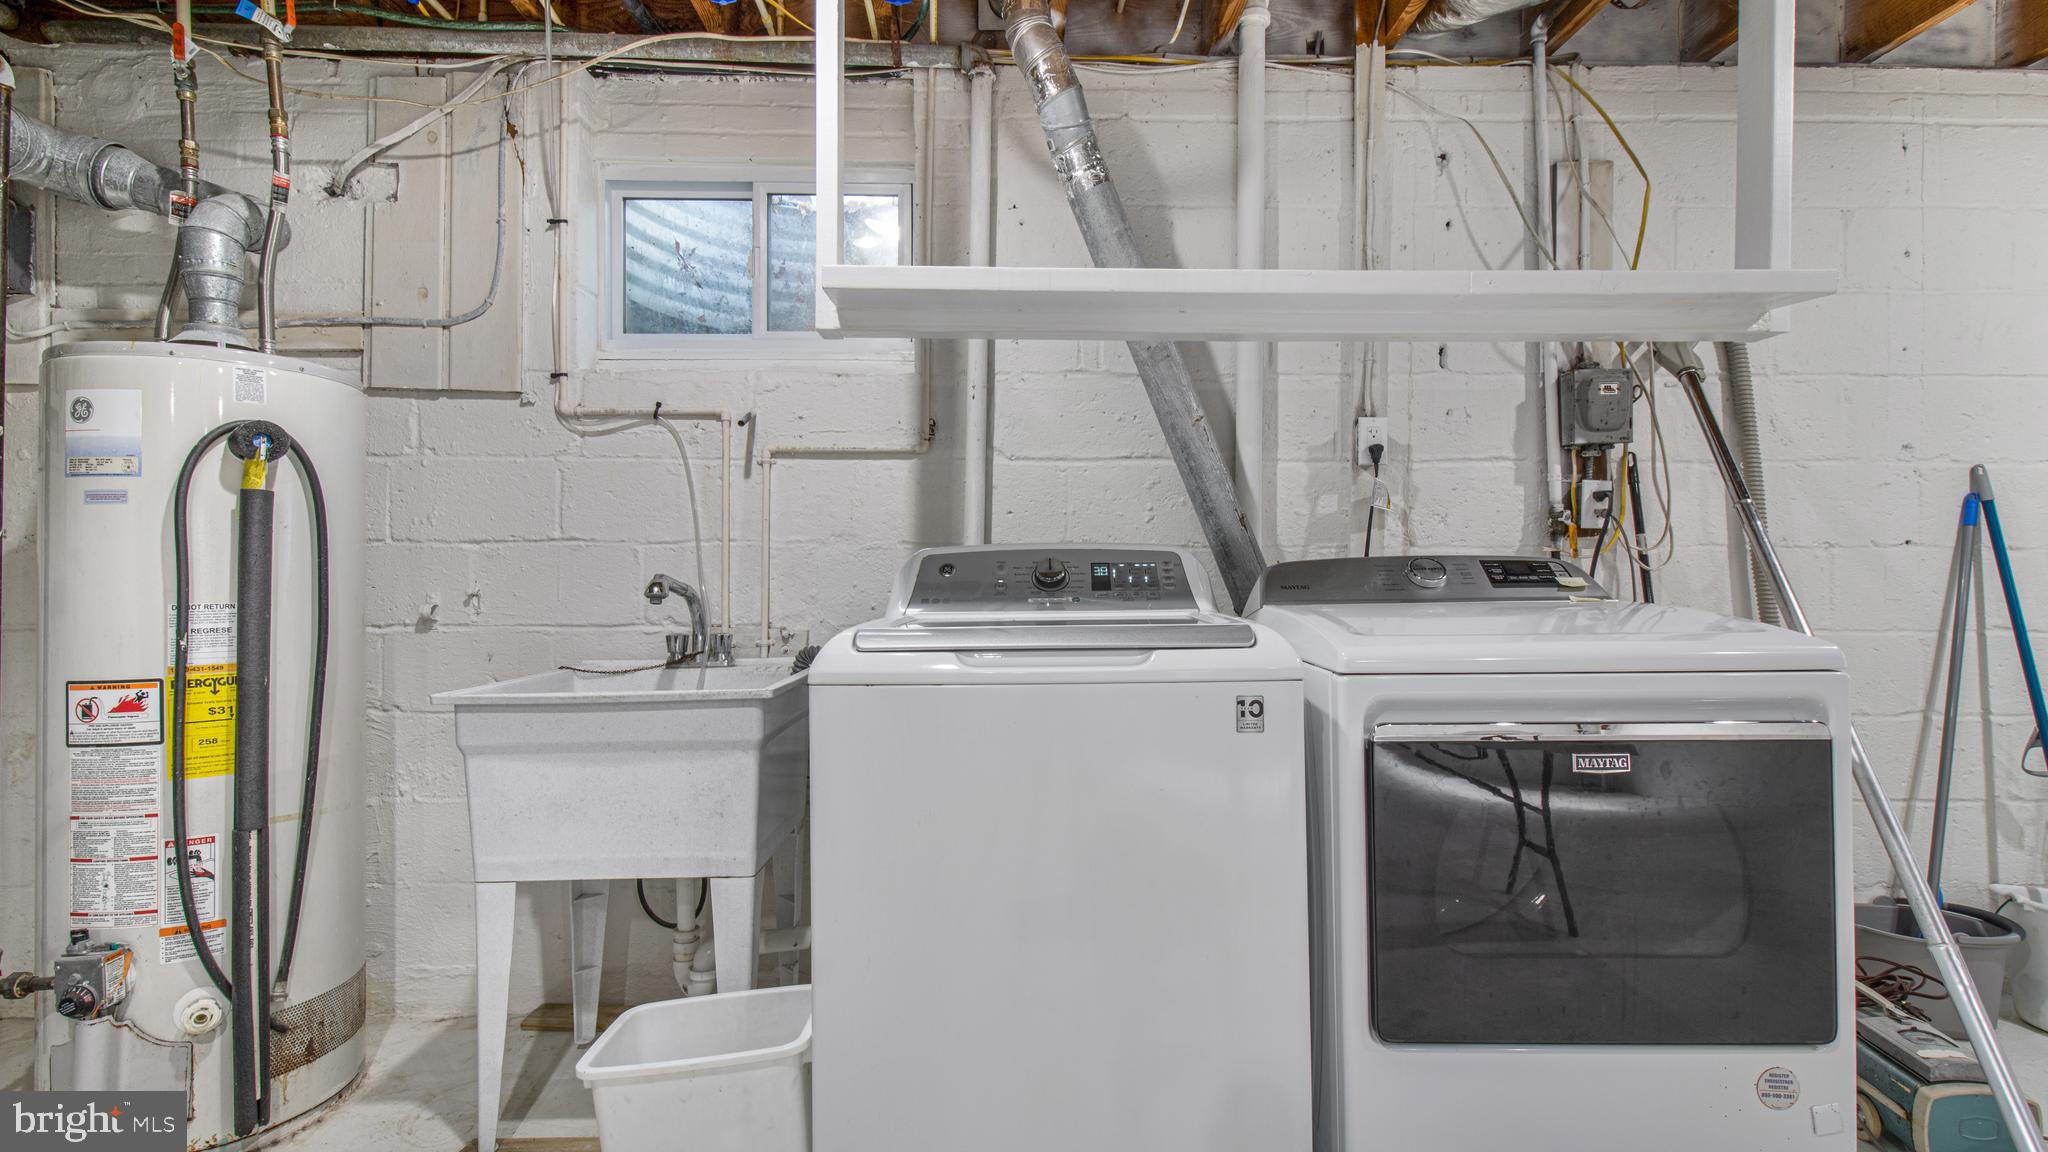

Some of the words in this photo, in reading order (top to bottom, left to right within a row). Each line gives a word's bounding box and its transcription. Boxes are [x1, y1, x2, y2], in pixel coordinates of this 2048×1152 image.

[190, 627, 233, 635] REGRESE
[198, 738, 218, 746] 258
[1577, 757, 1627, 768] MAYTAG
